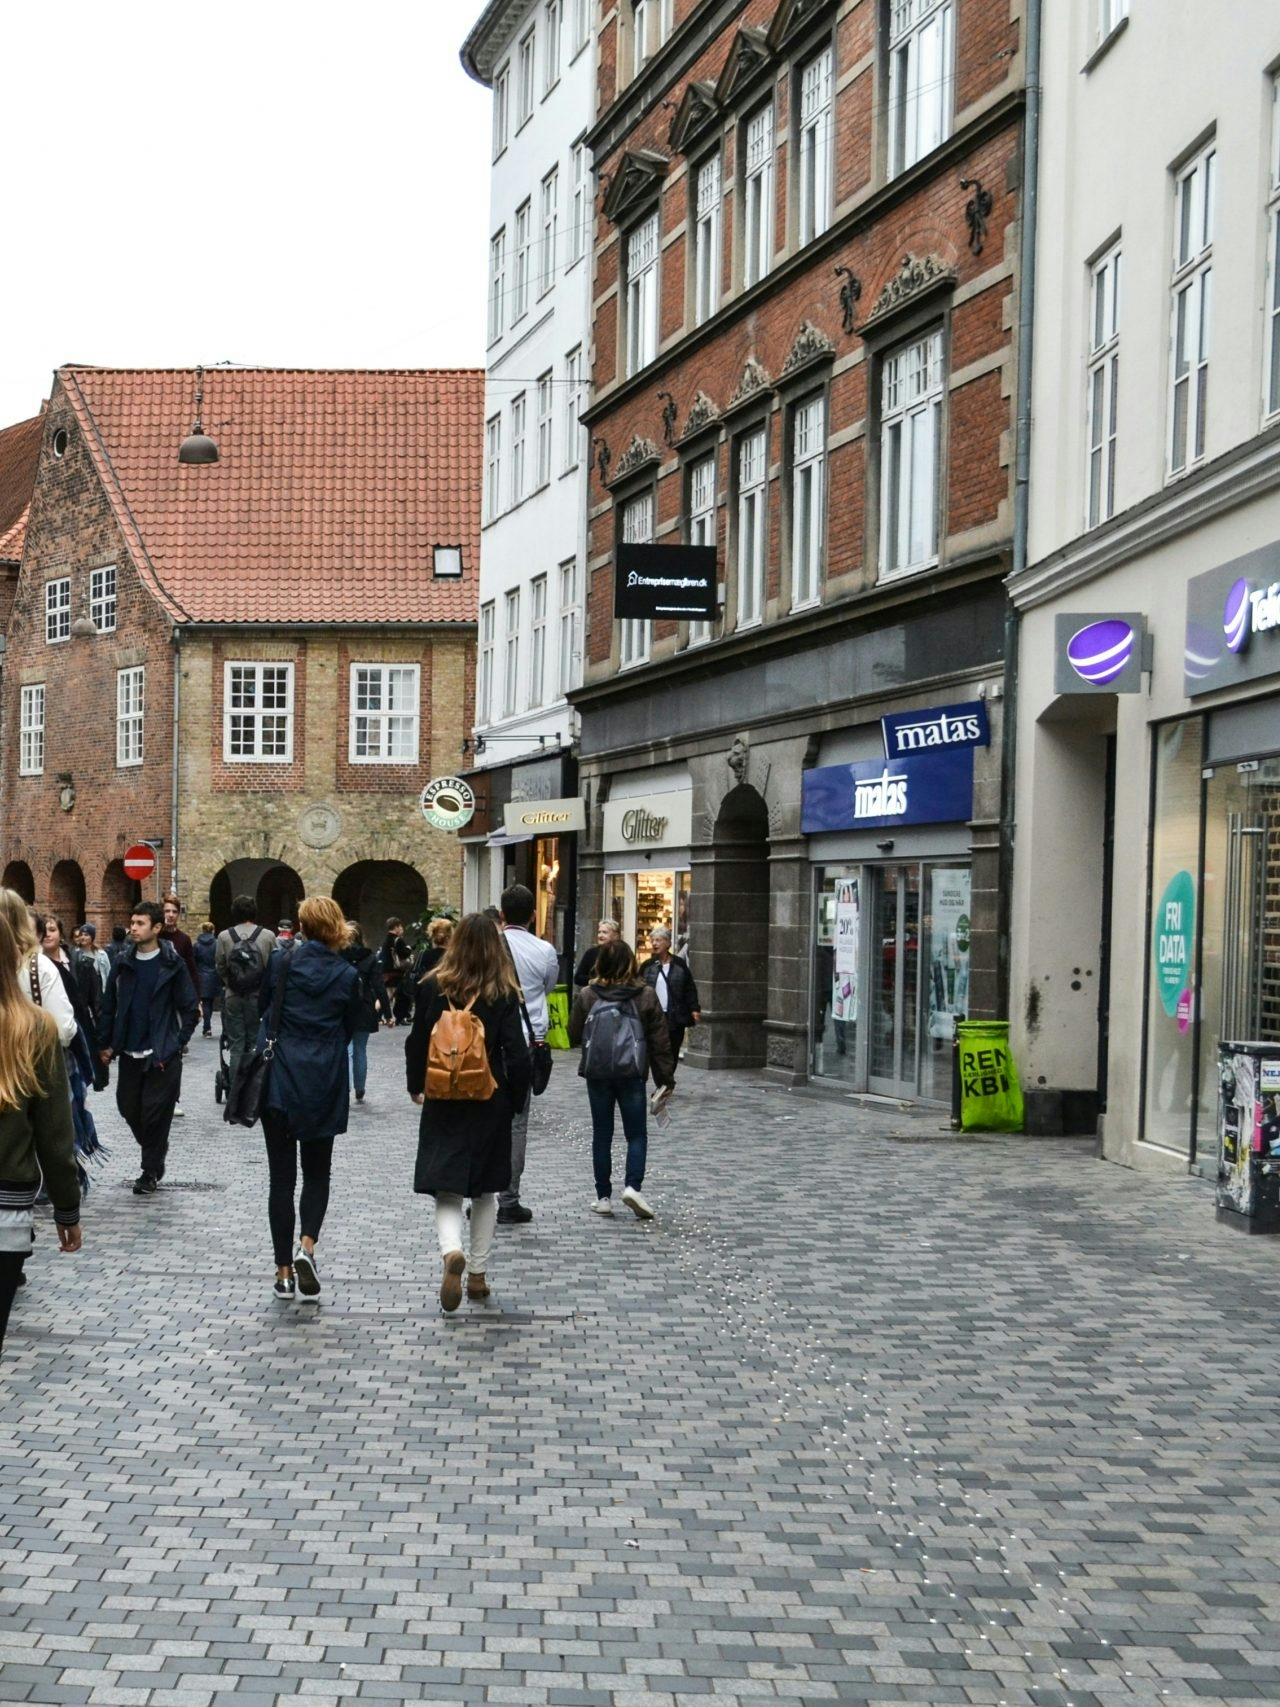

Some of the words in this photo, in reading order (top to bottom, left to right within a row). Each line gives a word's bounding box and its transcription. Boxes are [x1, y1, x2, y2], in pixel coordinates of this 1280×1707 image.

[1249, 581, 1280, 632] Teli
[894, 713, 982, 751] matas
[425, 780, 470, 800] ESPRESSO
[853, 767, 909, 819] matas
[431, 813, 466, 827] HOUSE
[521, 810, 571, 825] Glitter
[621, 808, 668, 842] Glitter
[1166, 902, 1182, 930] FRI
[1159, 934, 1186, 964] DATA
[963, 1048, 1006, 1072] REN
